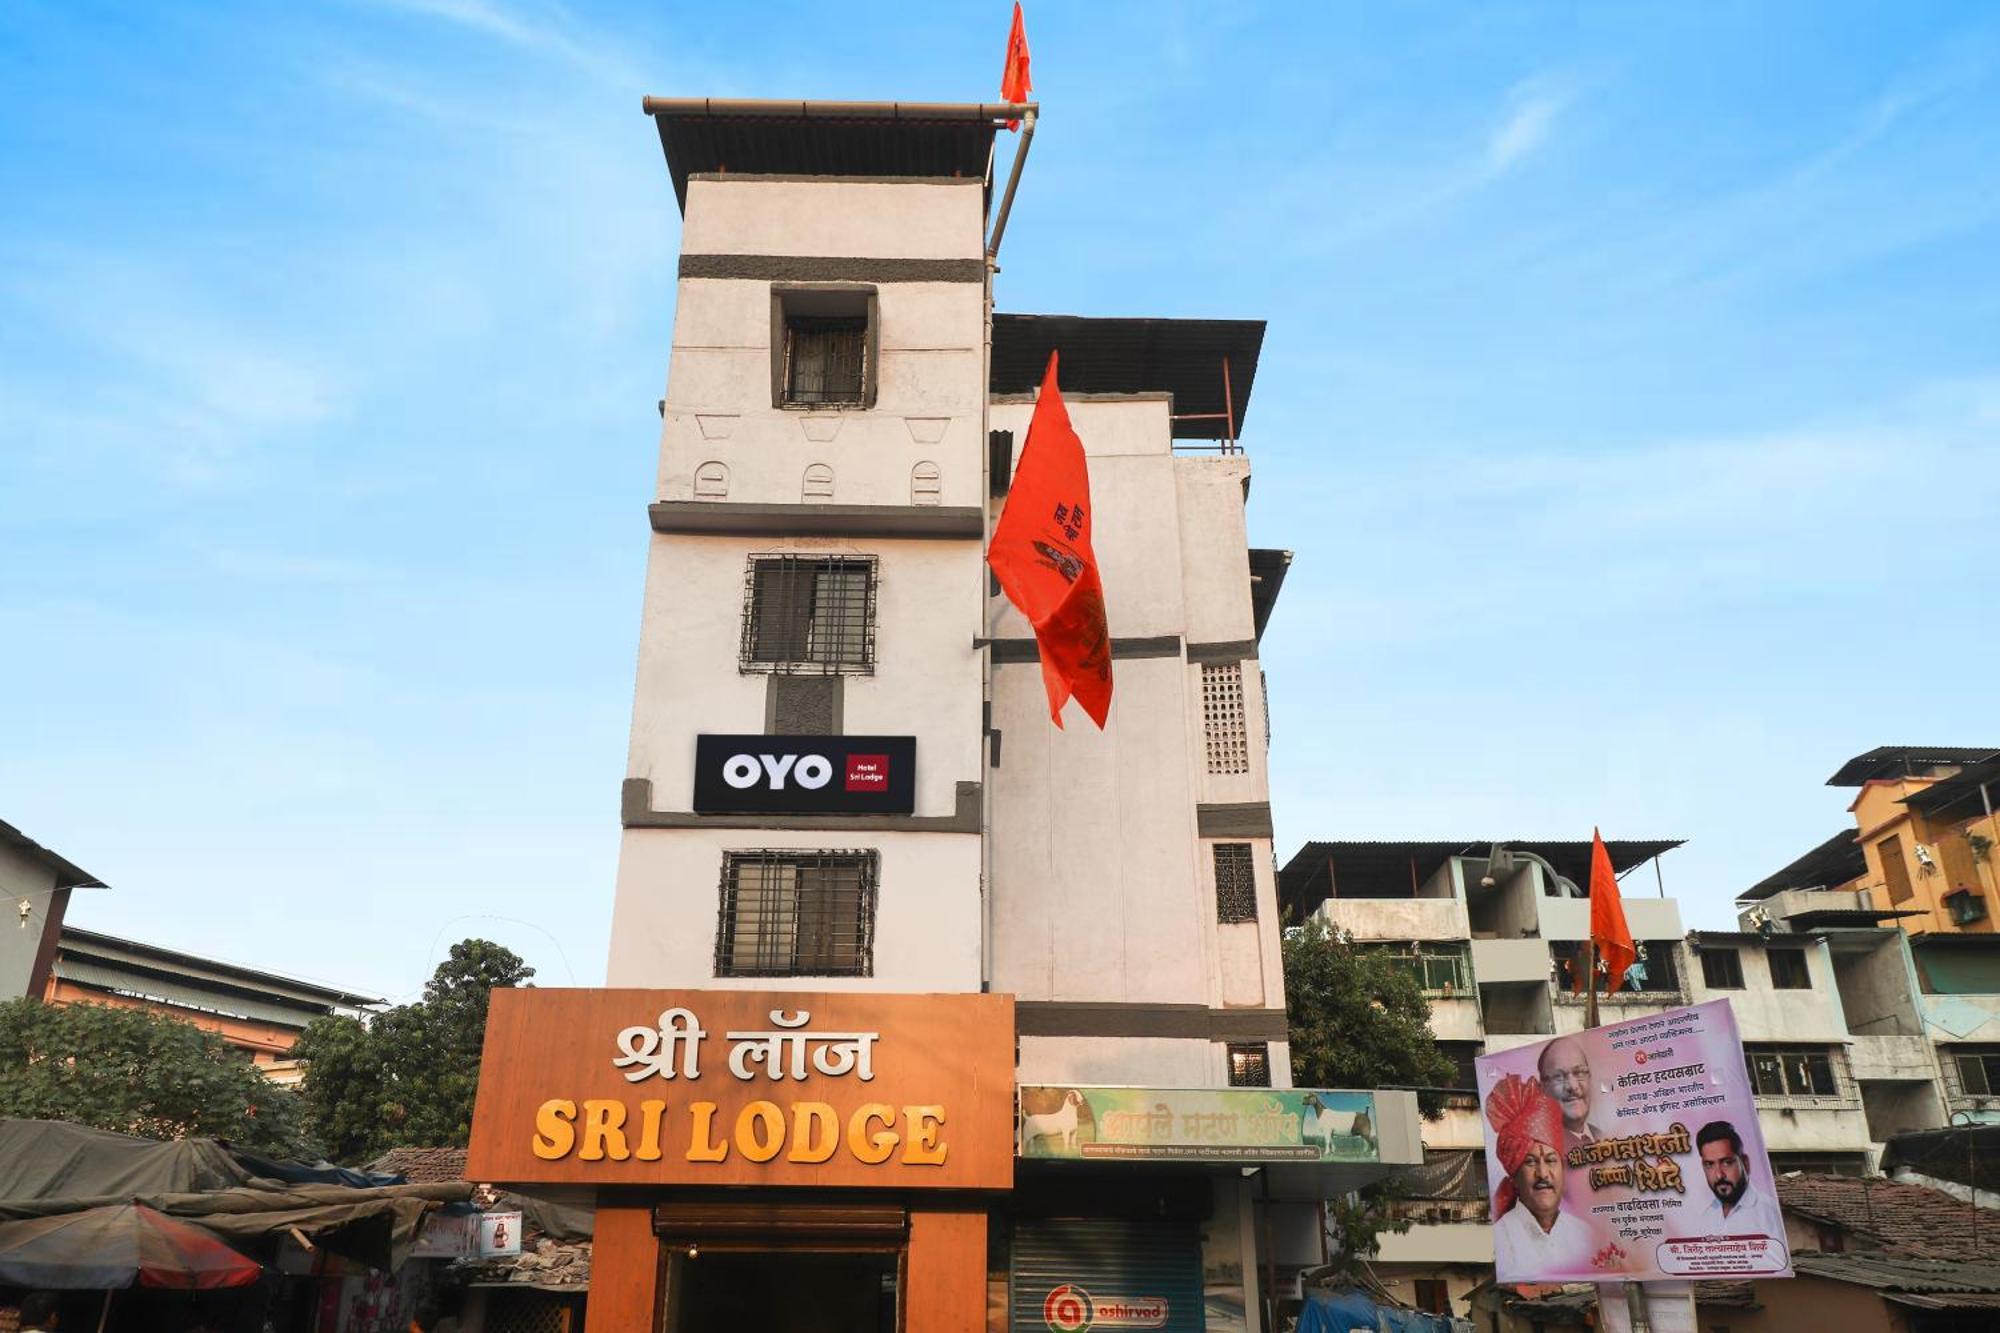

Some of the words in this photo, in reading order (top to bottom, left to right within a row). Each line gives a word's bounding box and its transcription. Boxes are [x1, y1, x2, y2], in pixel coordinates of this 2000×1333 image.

[723, 754, 833, 790] OYO
[850, 773, 860, 781] Sri
[861, 773, 883, 782] Lodge
[857, 764, 877, 772] Hotel
[613, 1007, 707, 1082] श्री
[726, 1009, 879, 1082] लॉज
[1617, 1071, 1652, 1088] केमिस्ट
[532, 1099, 668, 1162] SRI
[685, 1101, 948, 1166] LODGE
